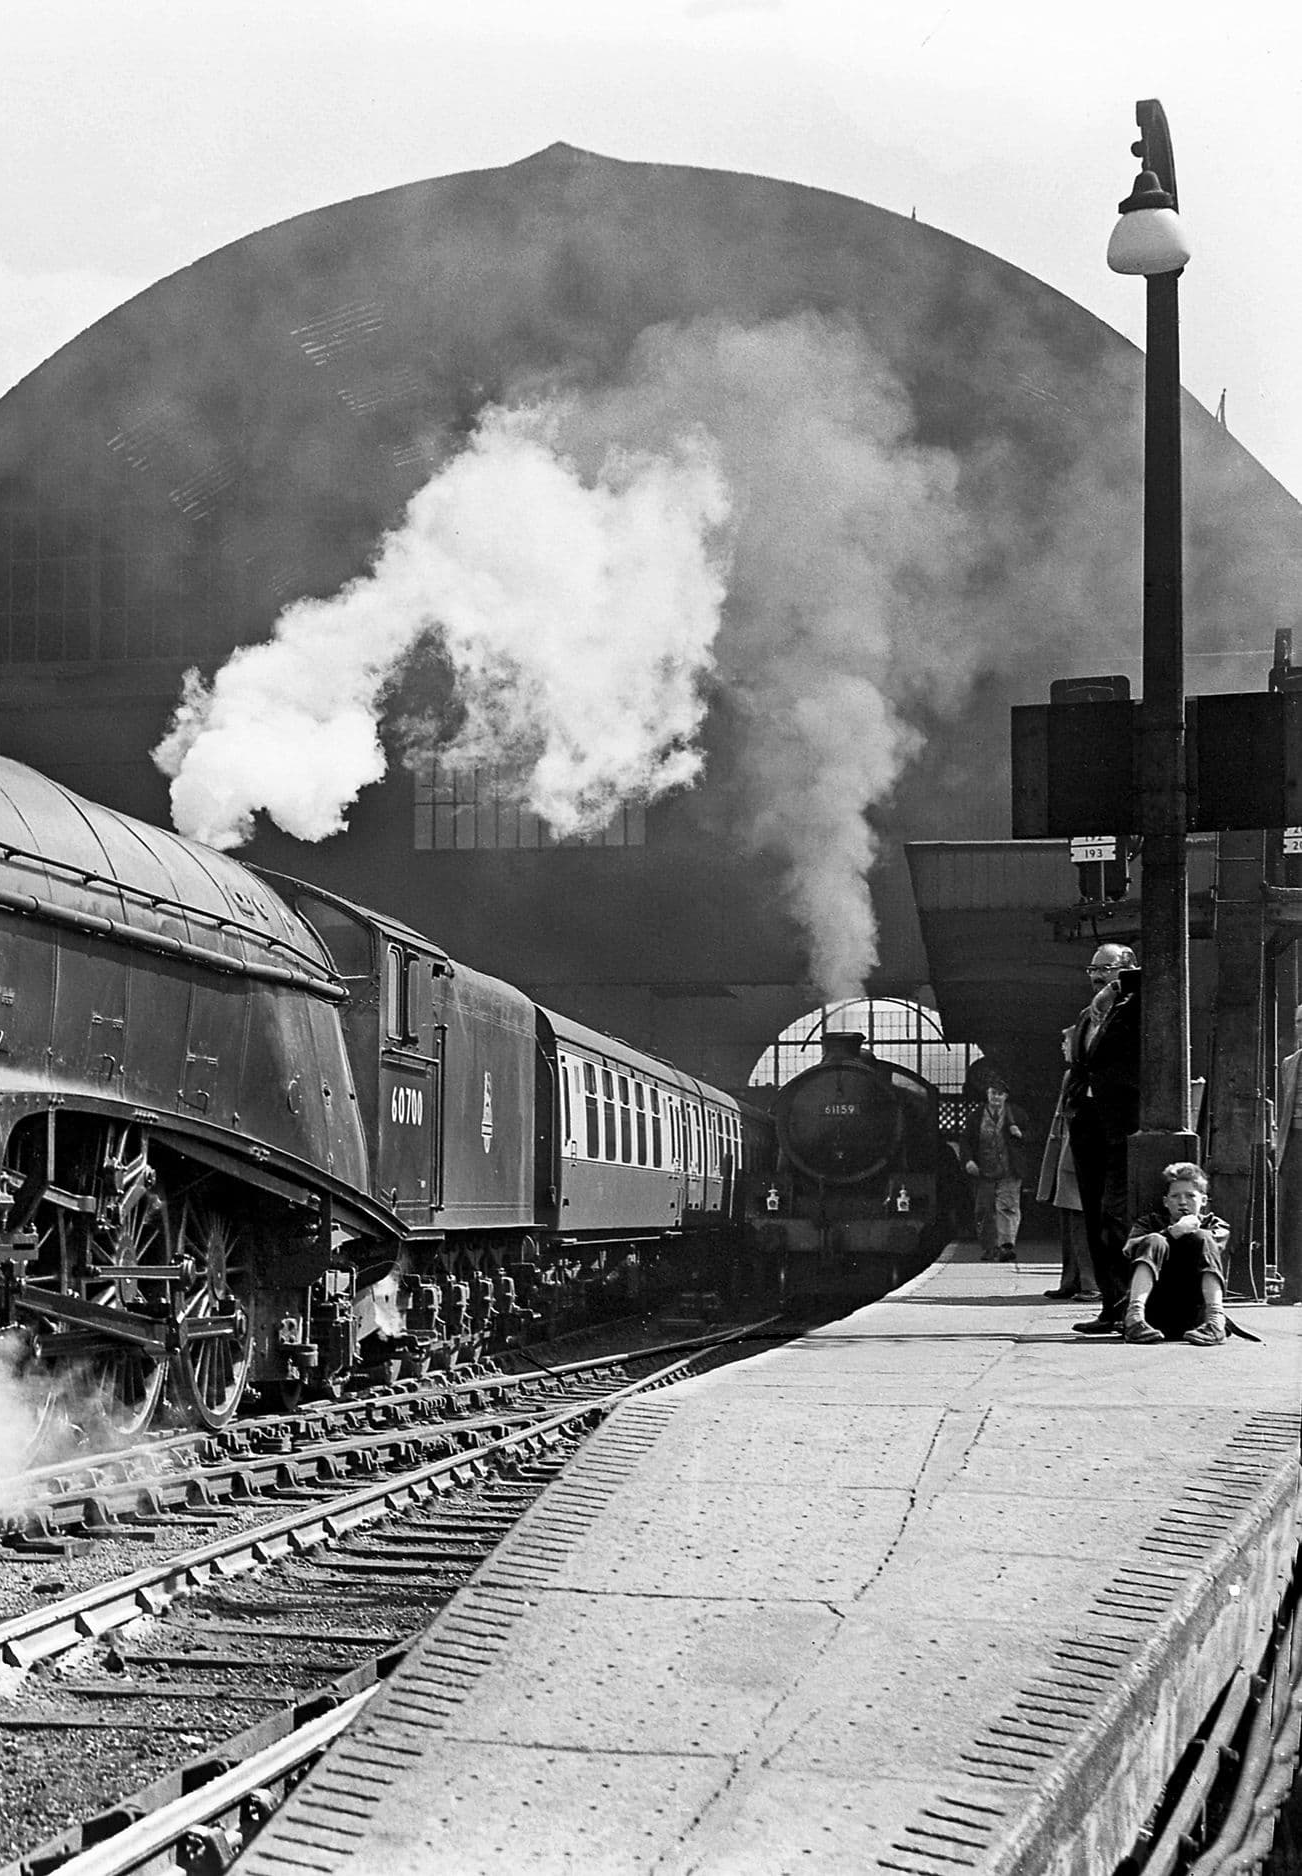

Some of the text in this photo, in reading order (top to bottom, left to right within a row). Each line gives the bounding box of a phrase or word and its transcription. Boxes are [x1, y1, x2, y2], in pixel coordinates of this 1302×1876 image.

[1085, 848, 1103, 859] 193
[392, 1086, 423, 1126] 60700
[825, 1104, 855, 1115] 61159
